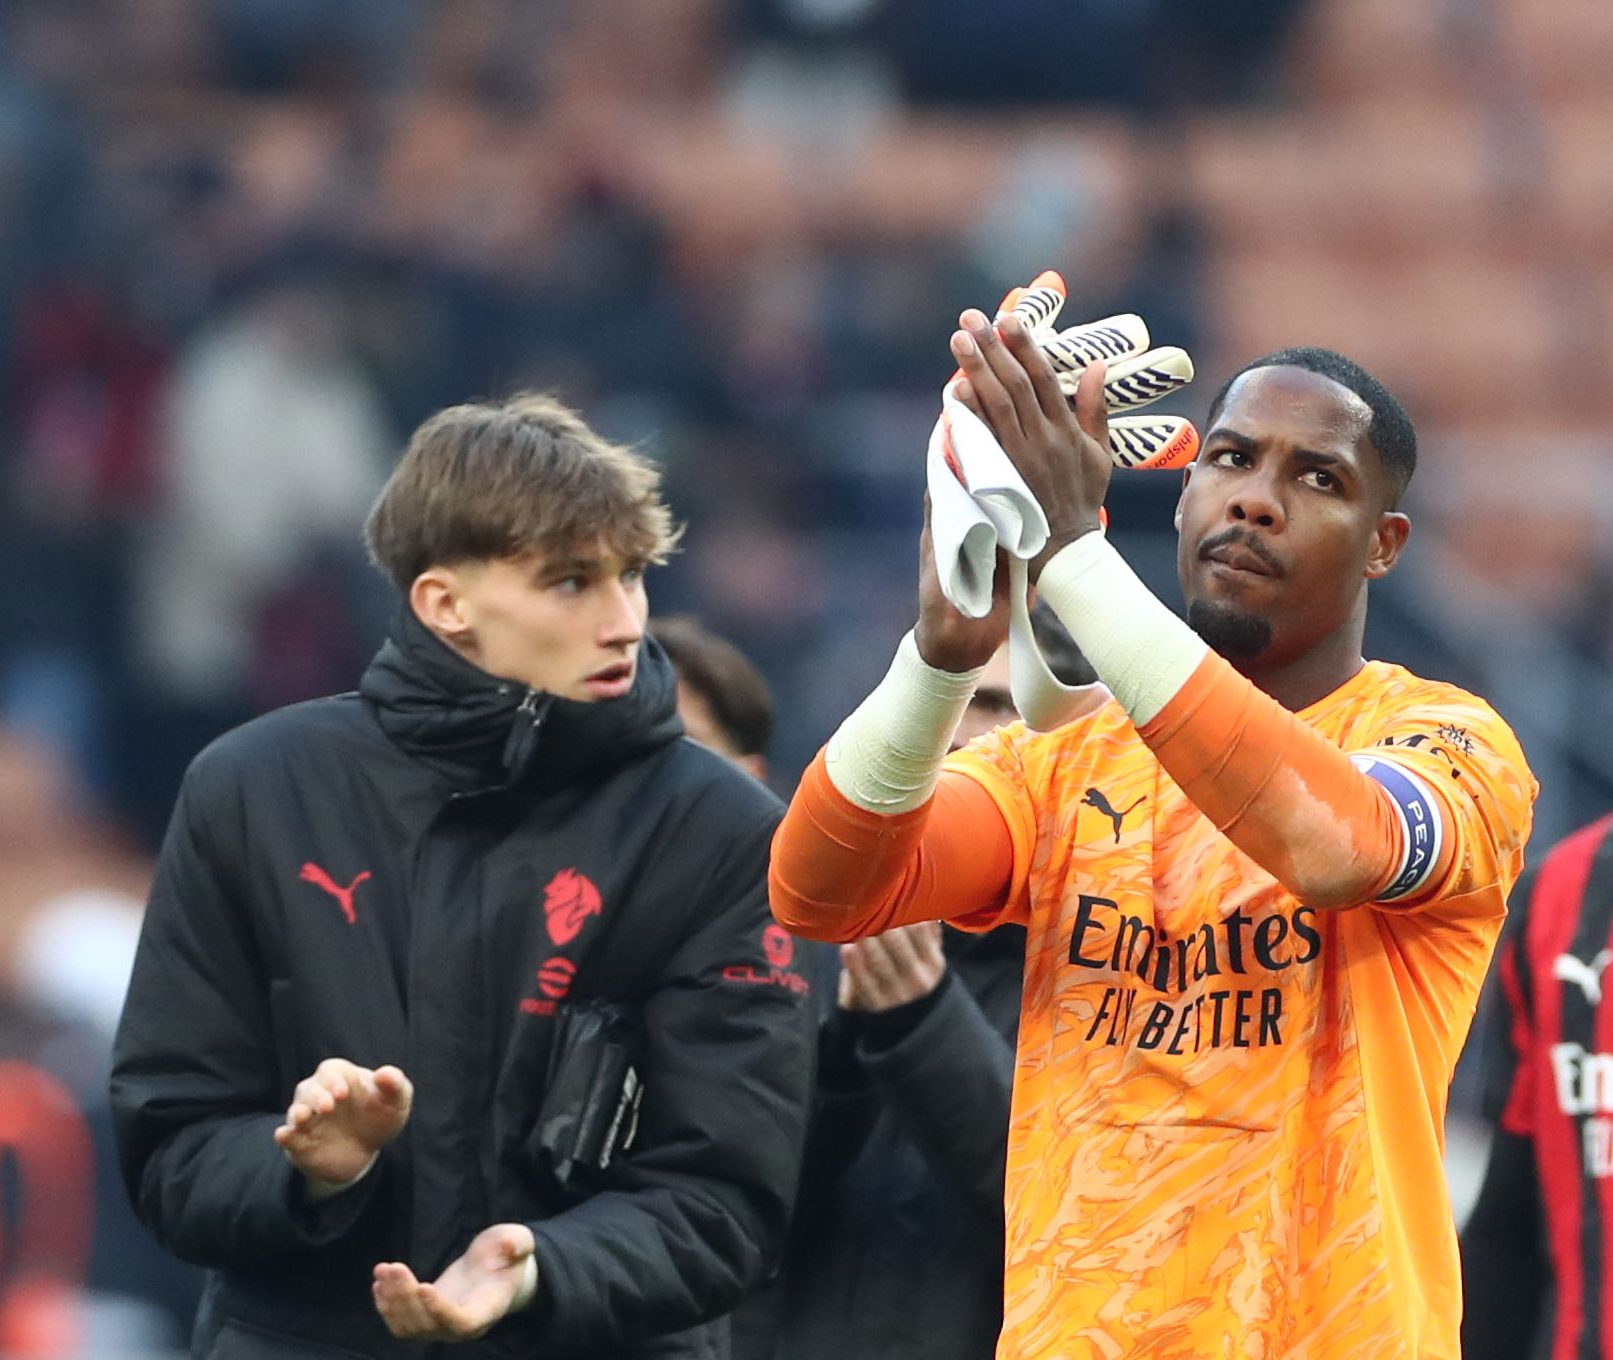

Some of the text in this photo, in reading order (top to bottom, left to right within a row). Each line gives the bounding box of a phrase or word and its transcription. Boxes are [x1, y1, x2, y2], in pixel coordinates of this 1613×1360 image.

[1155, 427, 1194, 468] uhlspor
[1069, 893, 1322, 993] Emirates
[1085, 987, 1283, 1056] FLY BETTER
